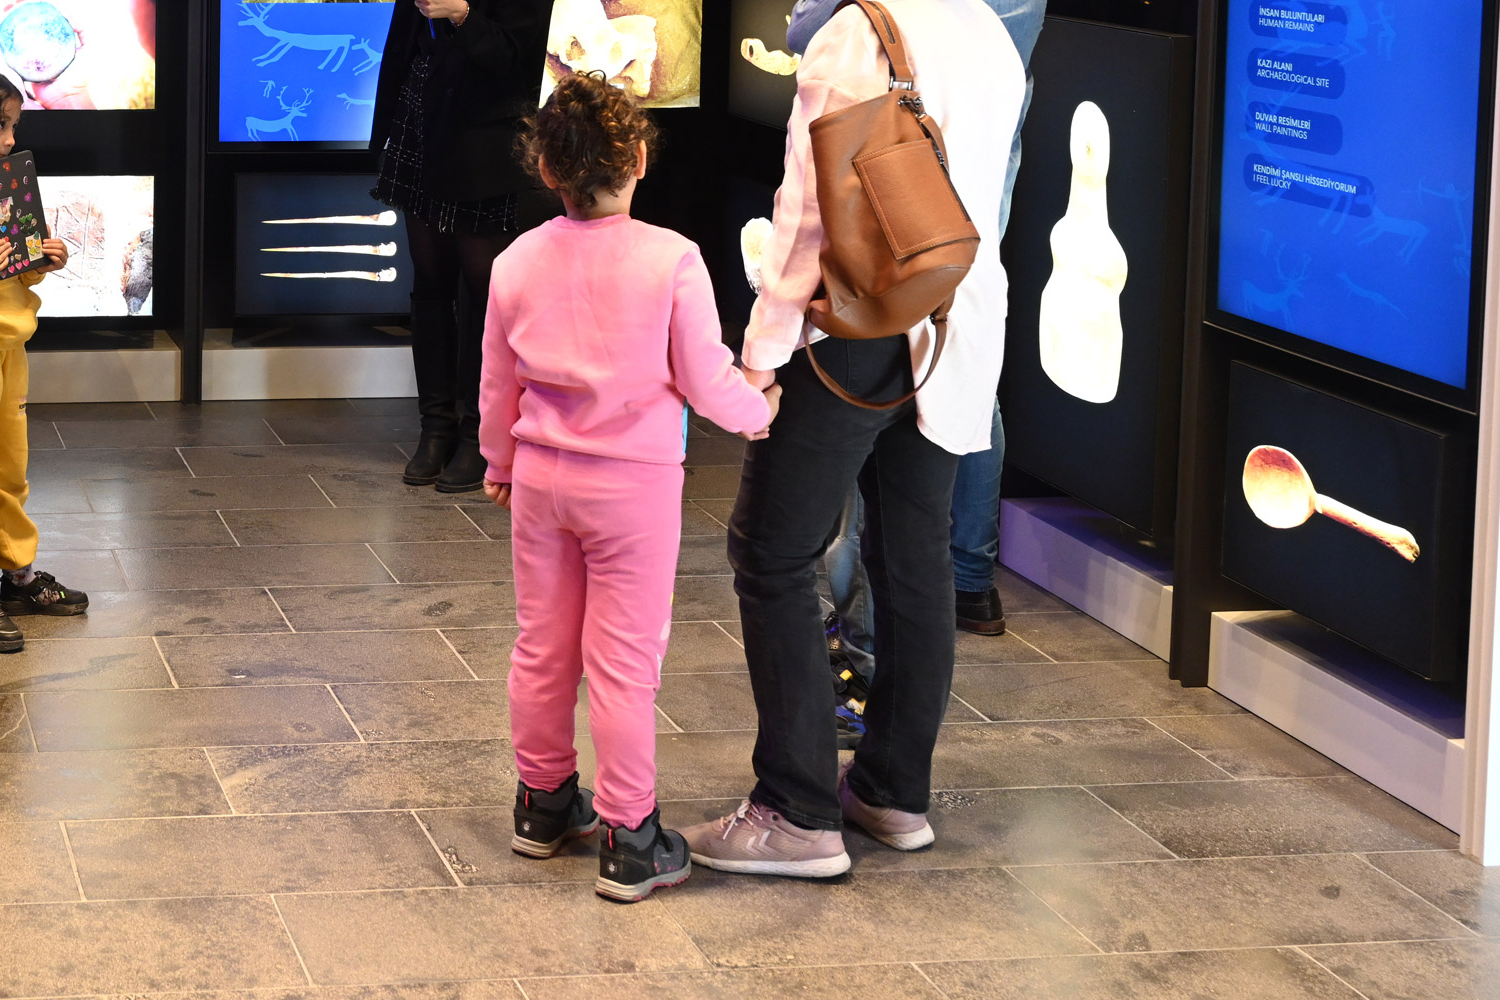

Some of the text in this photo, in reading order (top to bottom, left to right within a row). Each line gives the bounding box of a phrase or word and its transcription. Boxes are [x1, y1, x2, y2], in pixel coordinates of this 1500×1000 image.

[1280, 10, 1325, 23] BULUNTULARI
[1258, 17, 1315, 32] HUMAN REMAINS
[1257, 58, 1293, 71] KAZI ALANI
[1256, 68, 1330, 88] ARCHAEOLOGICAL SITE
[1255, 111, 1278, 124] DUVAR
[1254, 121, 1308, 140] WALL PAINTINGS
[1256, 174, 1270, 185] FEEL
[1270, 177, 1292, 190] LUCKY
